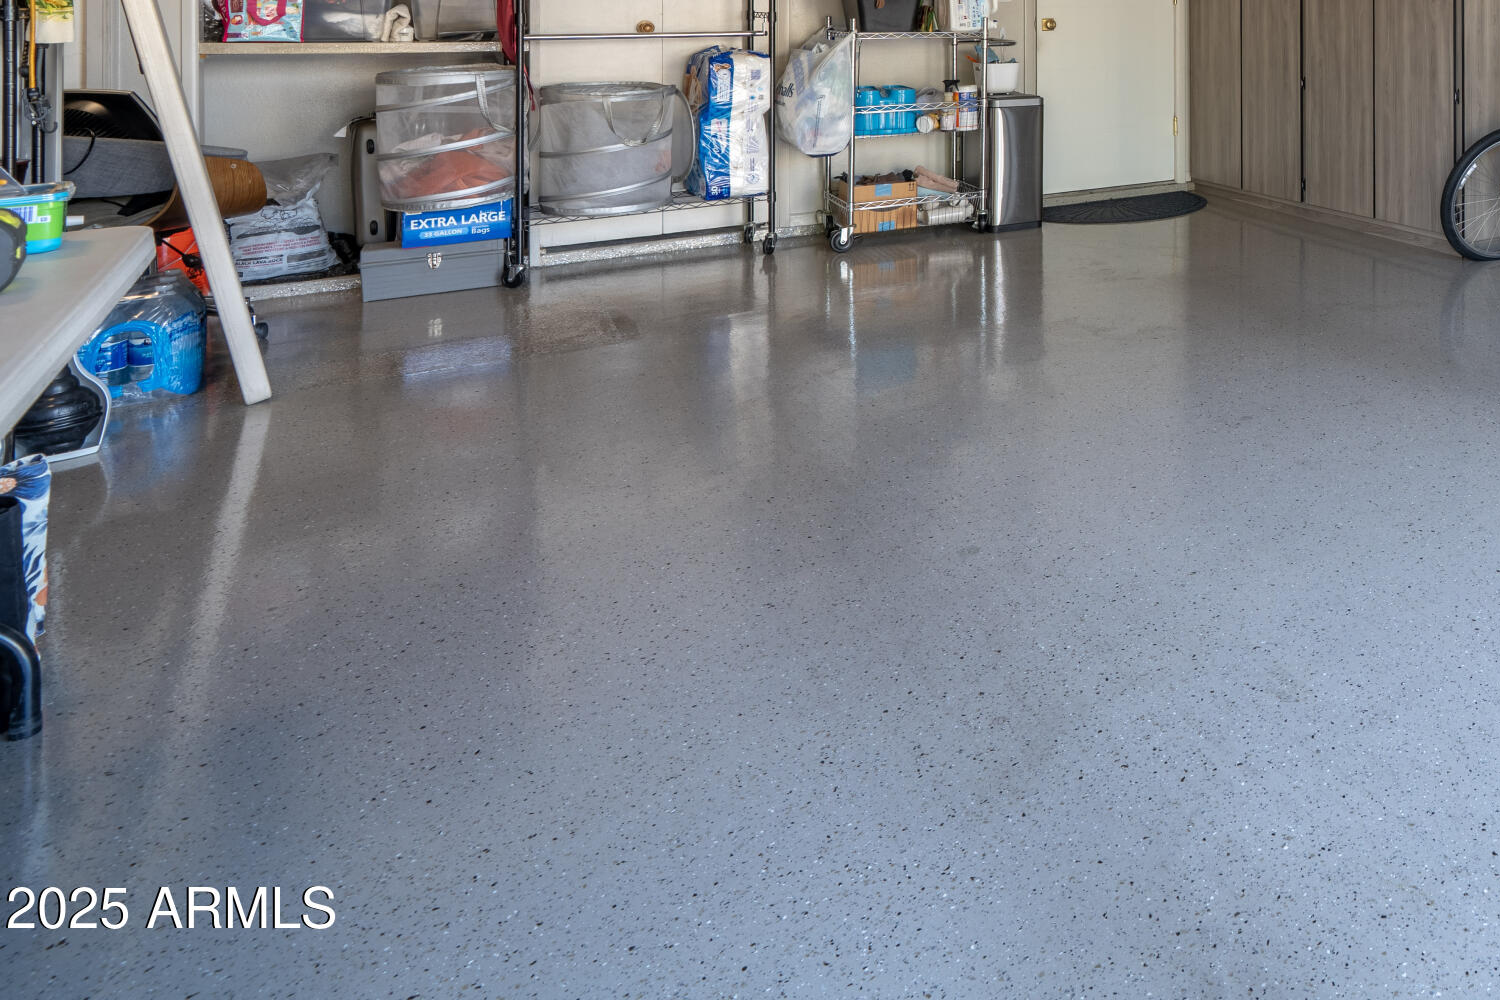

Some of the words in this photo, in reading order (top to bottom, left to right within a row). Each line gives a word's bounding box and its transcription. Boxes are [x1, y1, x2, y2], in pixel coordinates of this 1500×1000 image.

[410, 216, 457, 230] EXTRA
[461, 211, 506, 225] LARGE
[471, 226, 490, 235] Bags
